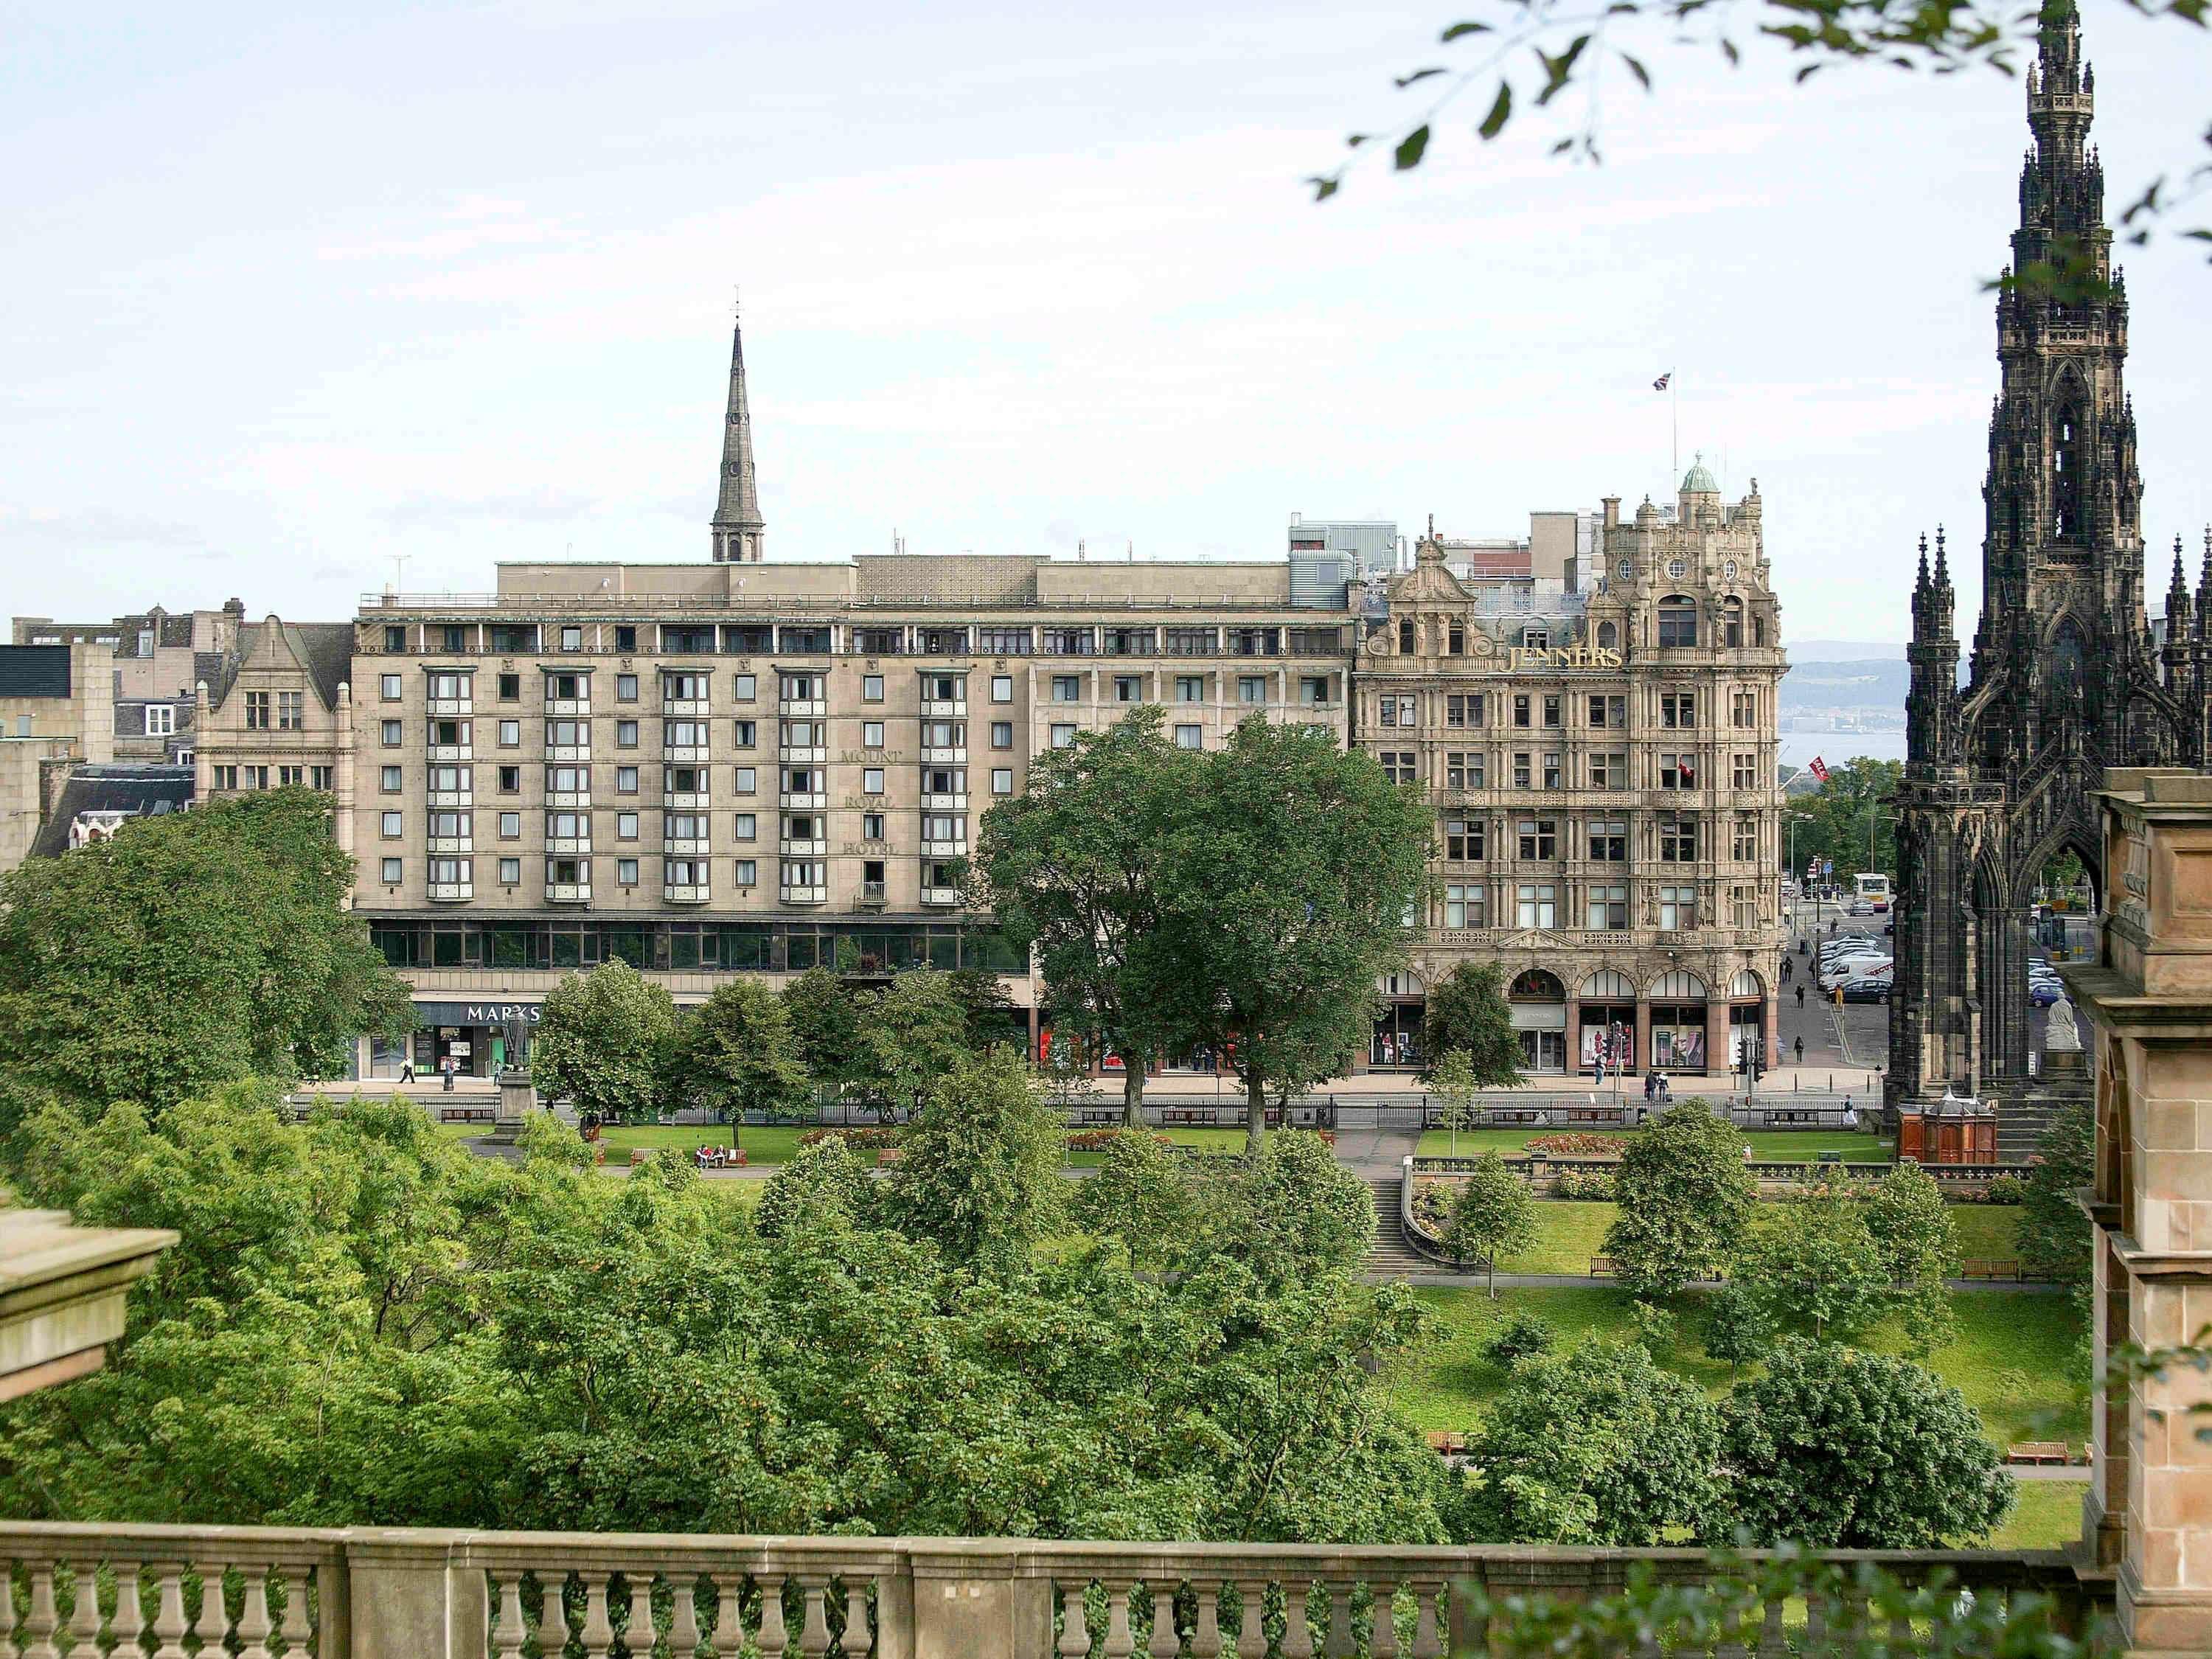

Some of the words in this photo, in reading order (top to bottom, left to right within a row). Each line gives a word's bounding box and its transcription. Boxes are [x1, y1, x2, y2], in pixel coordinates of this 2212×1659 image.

[1499, 647, 1623, 672] JENNERS
[841, 749, 902, 763] MOUNT
[844, 796, 896, 808] ROYAL
[844, 843, 897, 855] HOTEL
